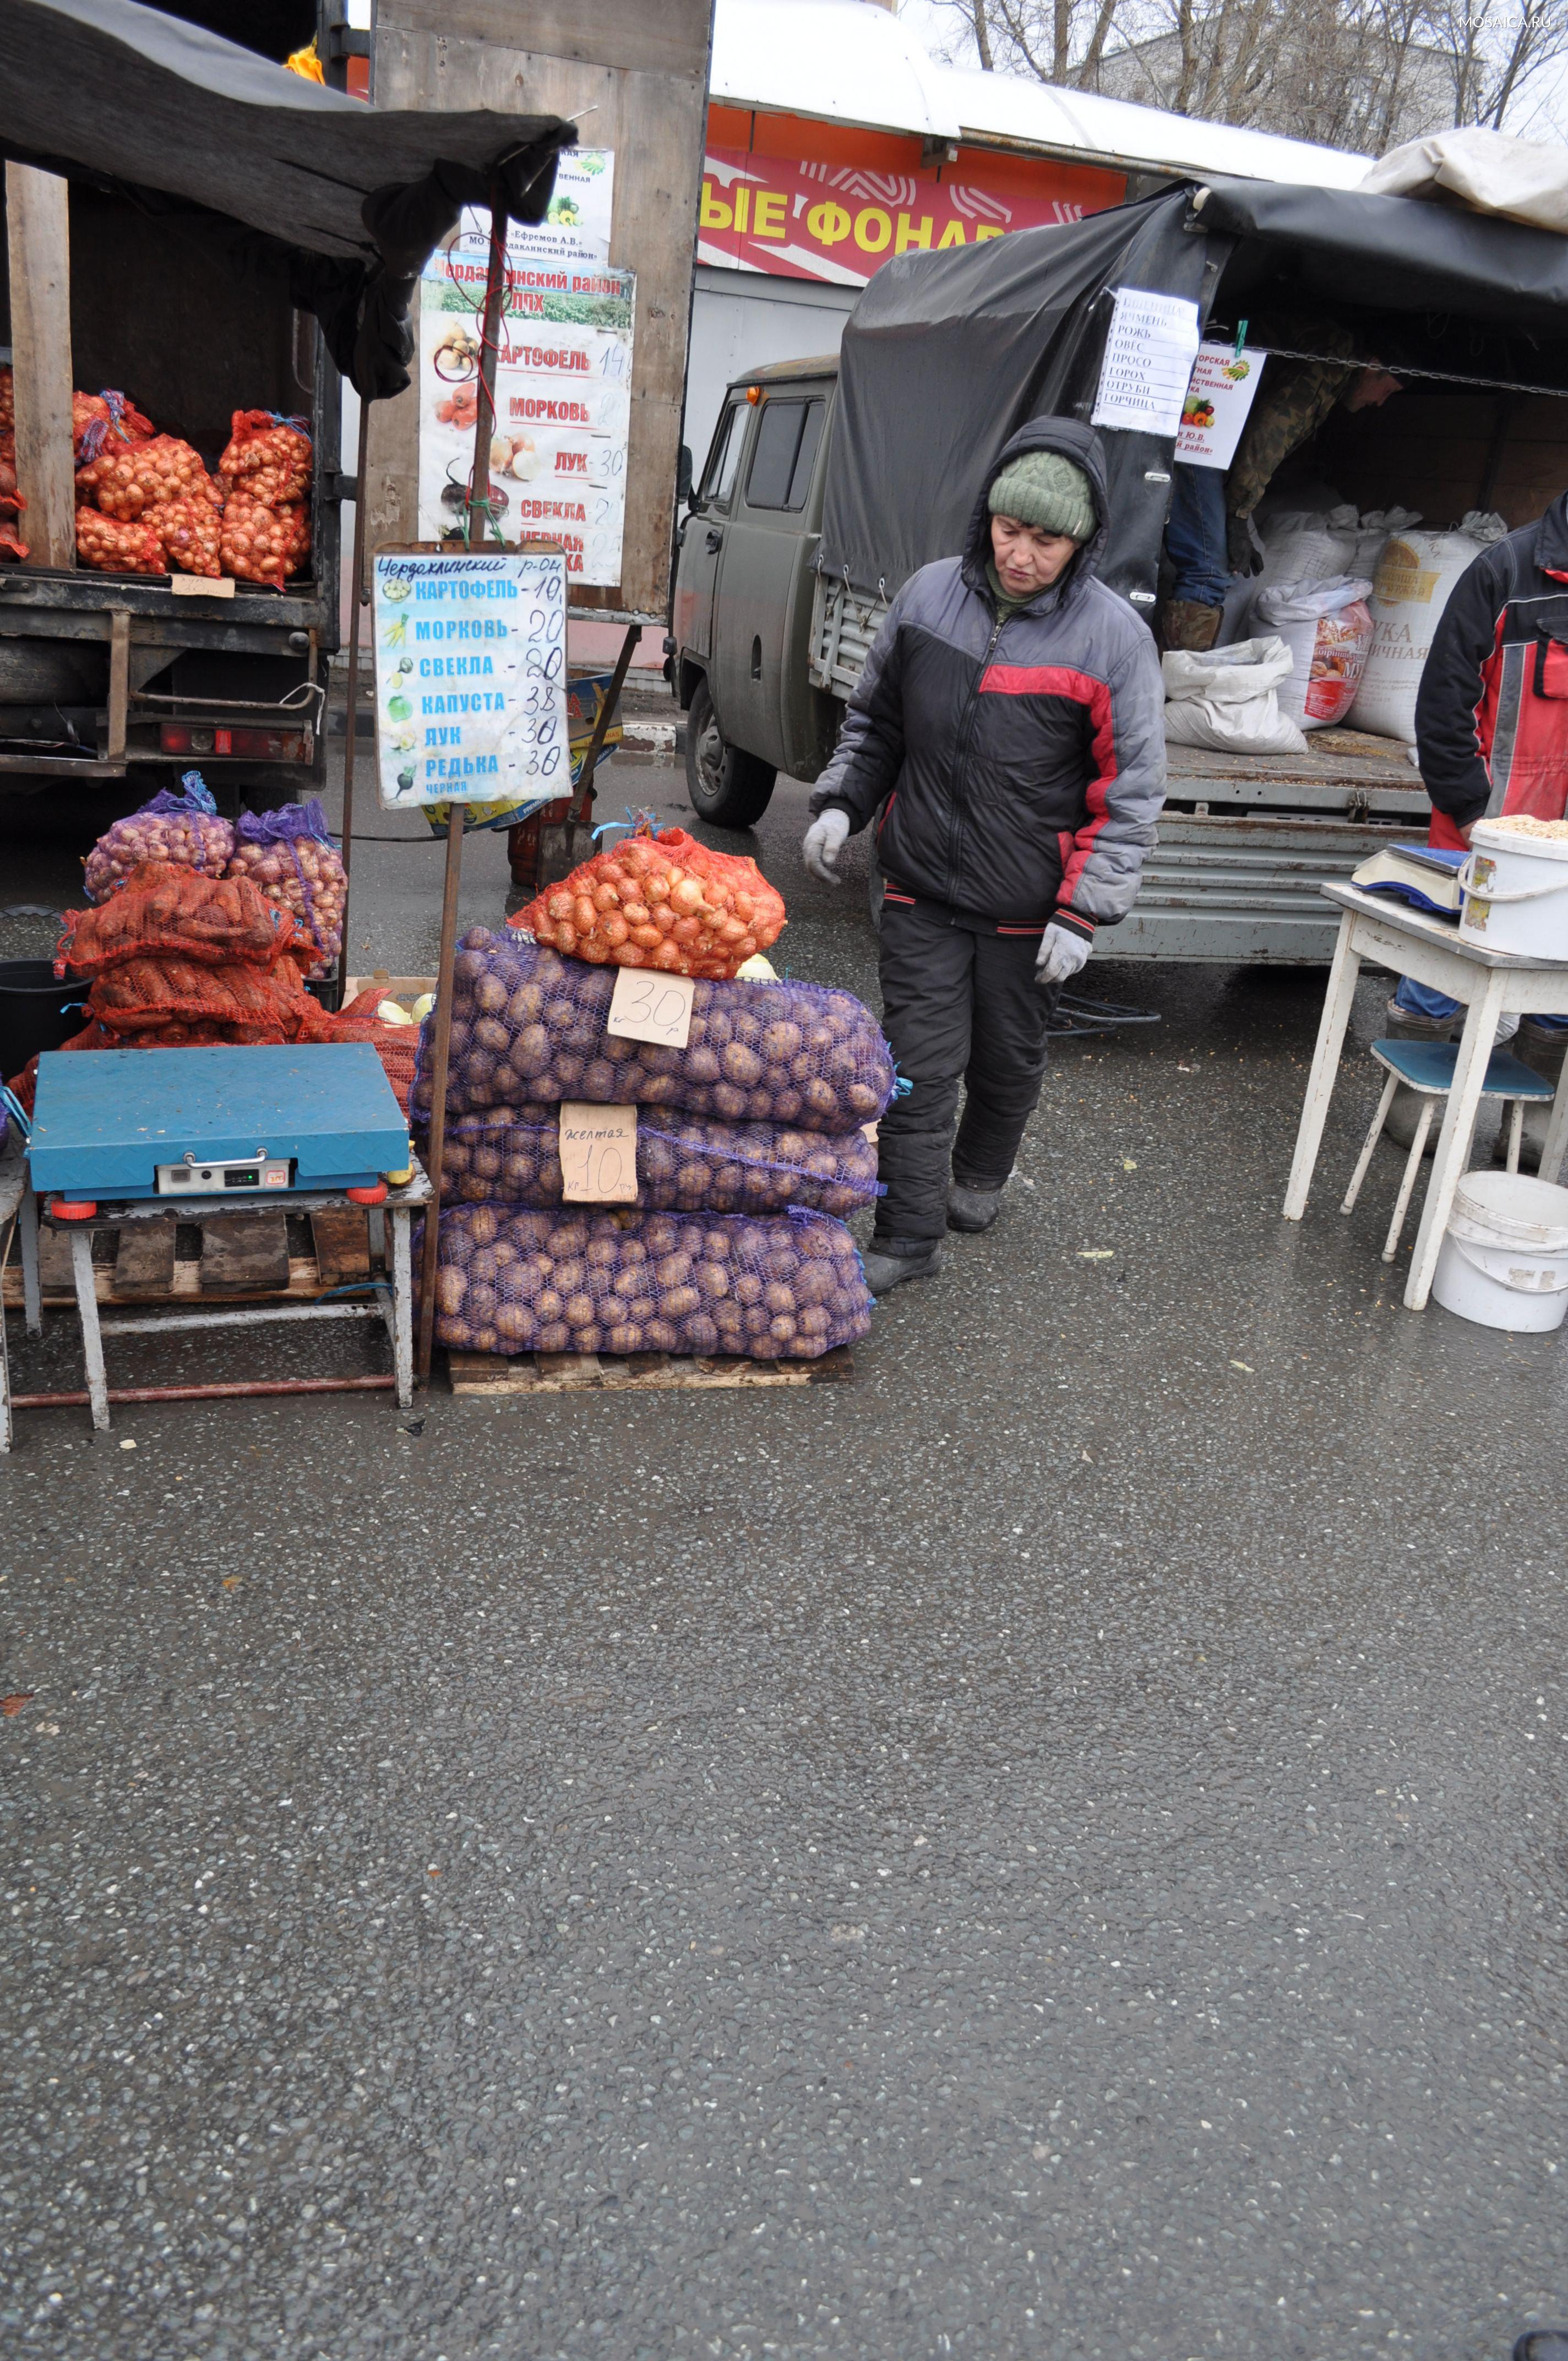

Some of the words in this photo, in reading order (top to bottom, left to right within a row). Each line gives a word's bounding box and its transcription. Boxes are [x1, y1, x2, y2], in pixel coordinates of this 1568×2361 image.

[557, 172, 591, 183] ВЕННАЯ
[469, 236, 484, 245] МО
[511, 231, 558, 244] «Ефремов
[573, 274, 621, 295] район
[512, 292, 544, 312] ЛПХ
[1120, 312, 1167, 327] ЯЧМЕНЬ
[1118, 325, 1151, 339] РОЖЬ
[1115, 339, 1145, 352] ОВЁС
[1112, 353, 1151, 367] ПРОСО
[1109, 367, 1146, 381] ГОРОХ
[1196, 366, 1212, 376] НАЯ
[1107, 380, 1150, 395] ОТРУБИ
[510, 397, 591, 422] МОРКОВЬ
[1104, 393, 1156, 410] ГОРЧИЦА
[554, 451, 588, 472] ЛУК
[599, 450, 623, 477] 30
[521, 499, 586, 522] СВЕКЛА
[416, 580, 518, 600] КАРТОФЕЛЬ
[416, 619, 508, 640] МОРКОВЬ
[528, 610, 564, 644] 20
[1368, 643, 1430, 661] ИЧНАЯ
[420, 656, 493, 677] СВЕКЛА
[422, 692, 505, 714] КАПУСТА
[524, 687, 556, 715] 38
[425, 726, 461, 746] ЛУК
[521, 716, 557, 744] 30
[426, 754, 499, 778] РЕДЬКА
[526, 746, 560, 776] 30
[426, 781, 467, 794] ЧЕРНАЯ
[626, 980, 685, 1027] 30
[578, 1145, 622, 1193] 10
